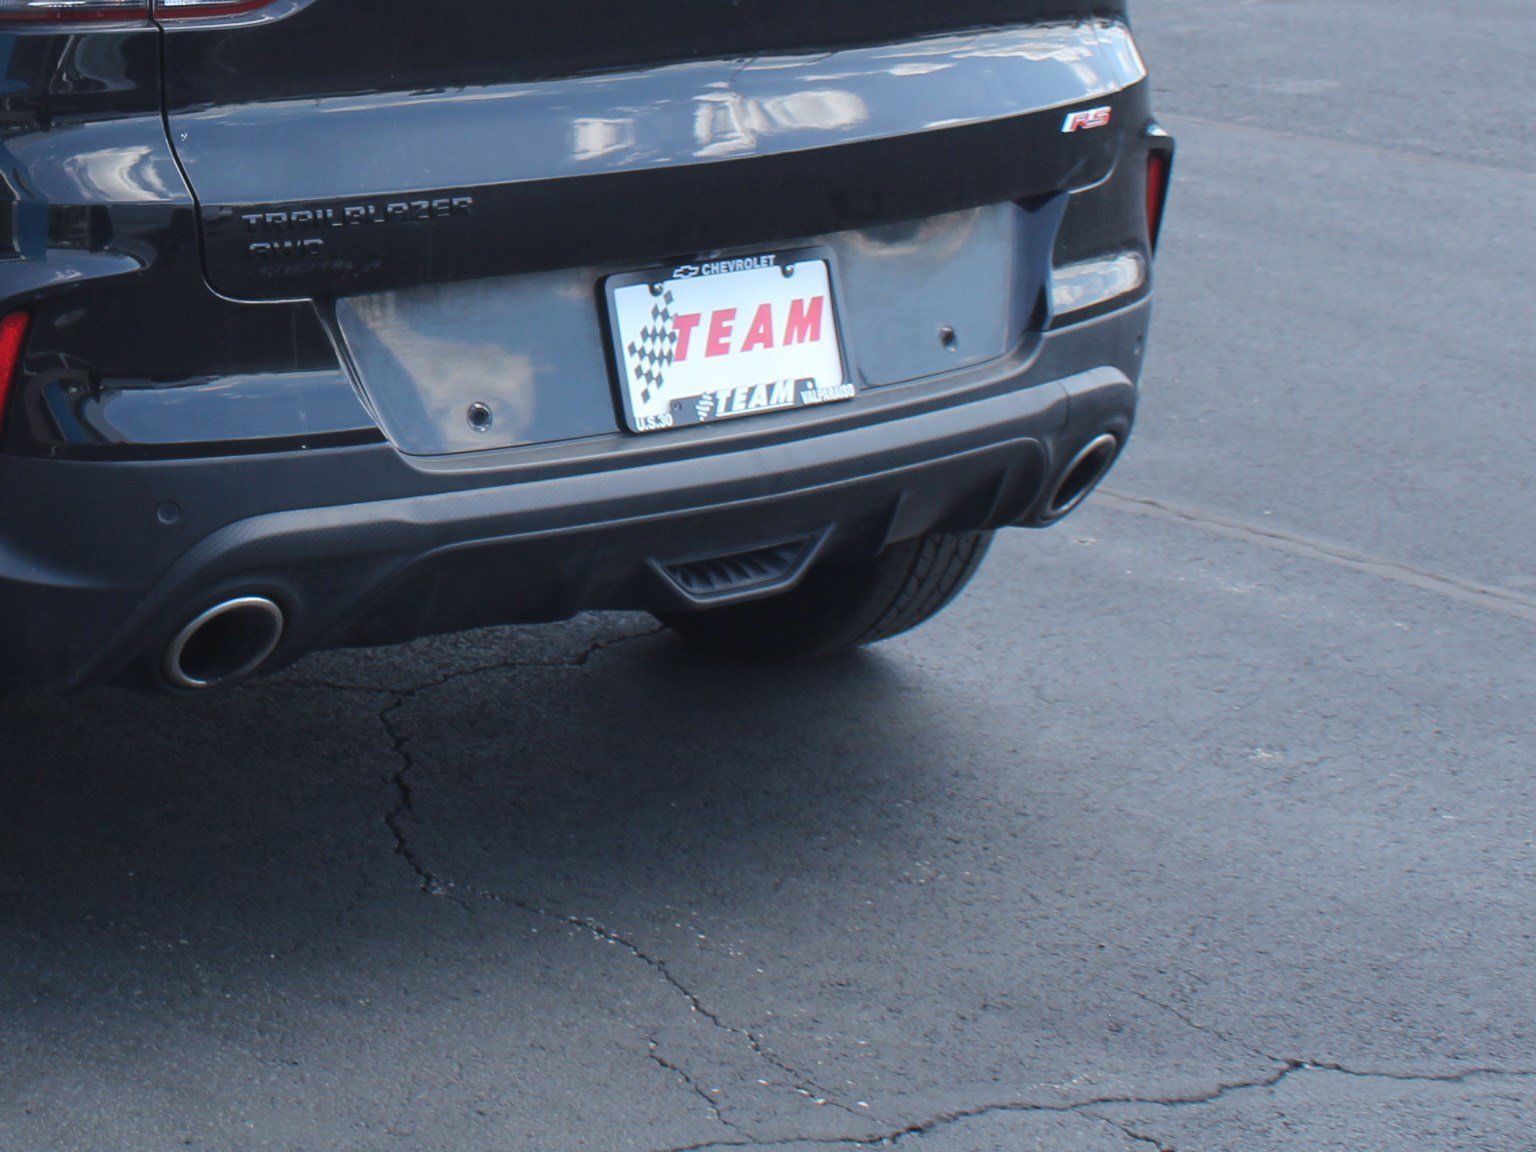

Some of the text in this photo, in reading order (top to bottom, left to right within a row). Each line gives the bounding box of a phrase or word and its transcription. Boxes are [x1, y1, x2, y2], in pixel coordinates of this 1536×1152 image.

[1060, 105, 1112, 133] RS
[241, 196, 473, 230] TRAILBLAZER
[700, 254, 776, 276] CHEVROLET
[671, 295, 825, 363] TEAM
[714, 379, 796, 415] TEAM
